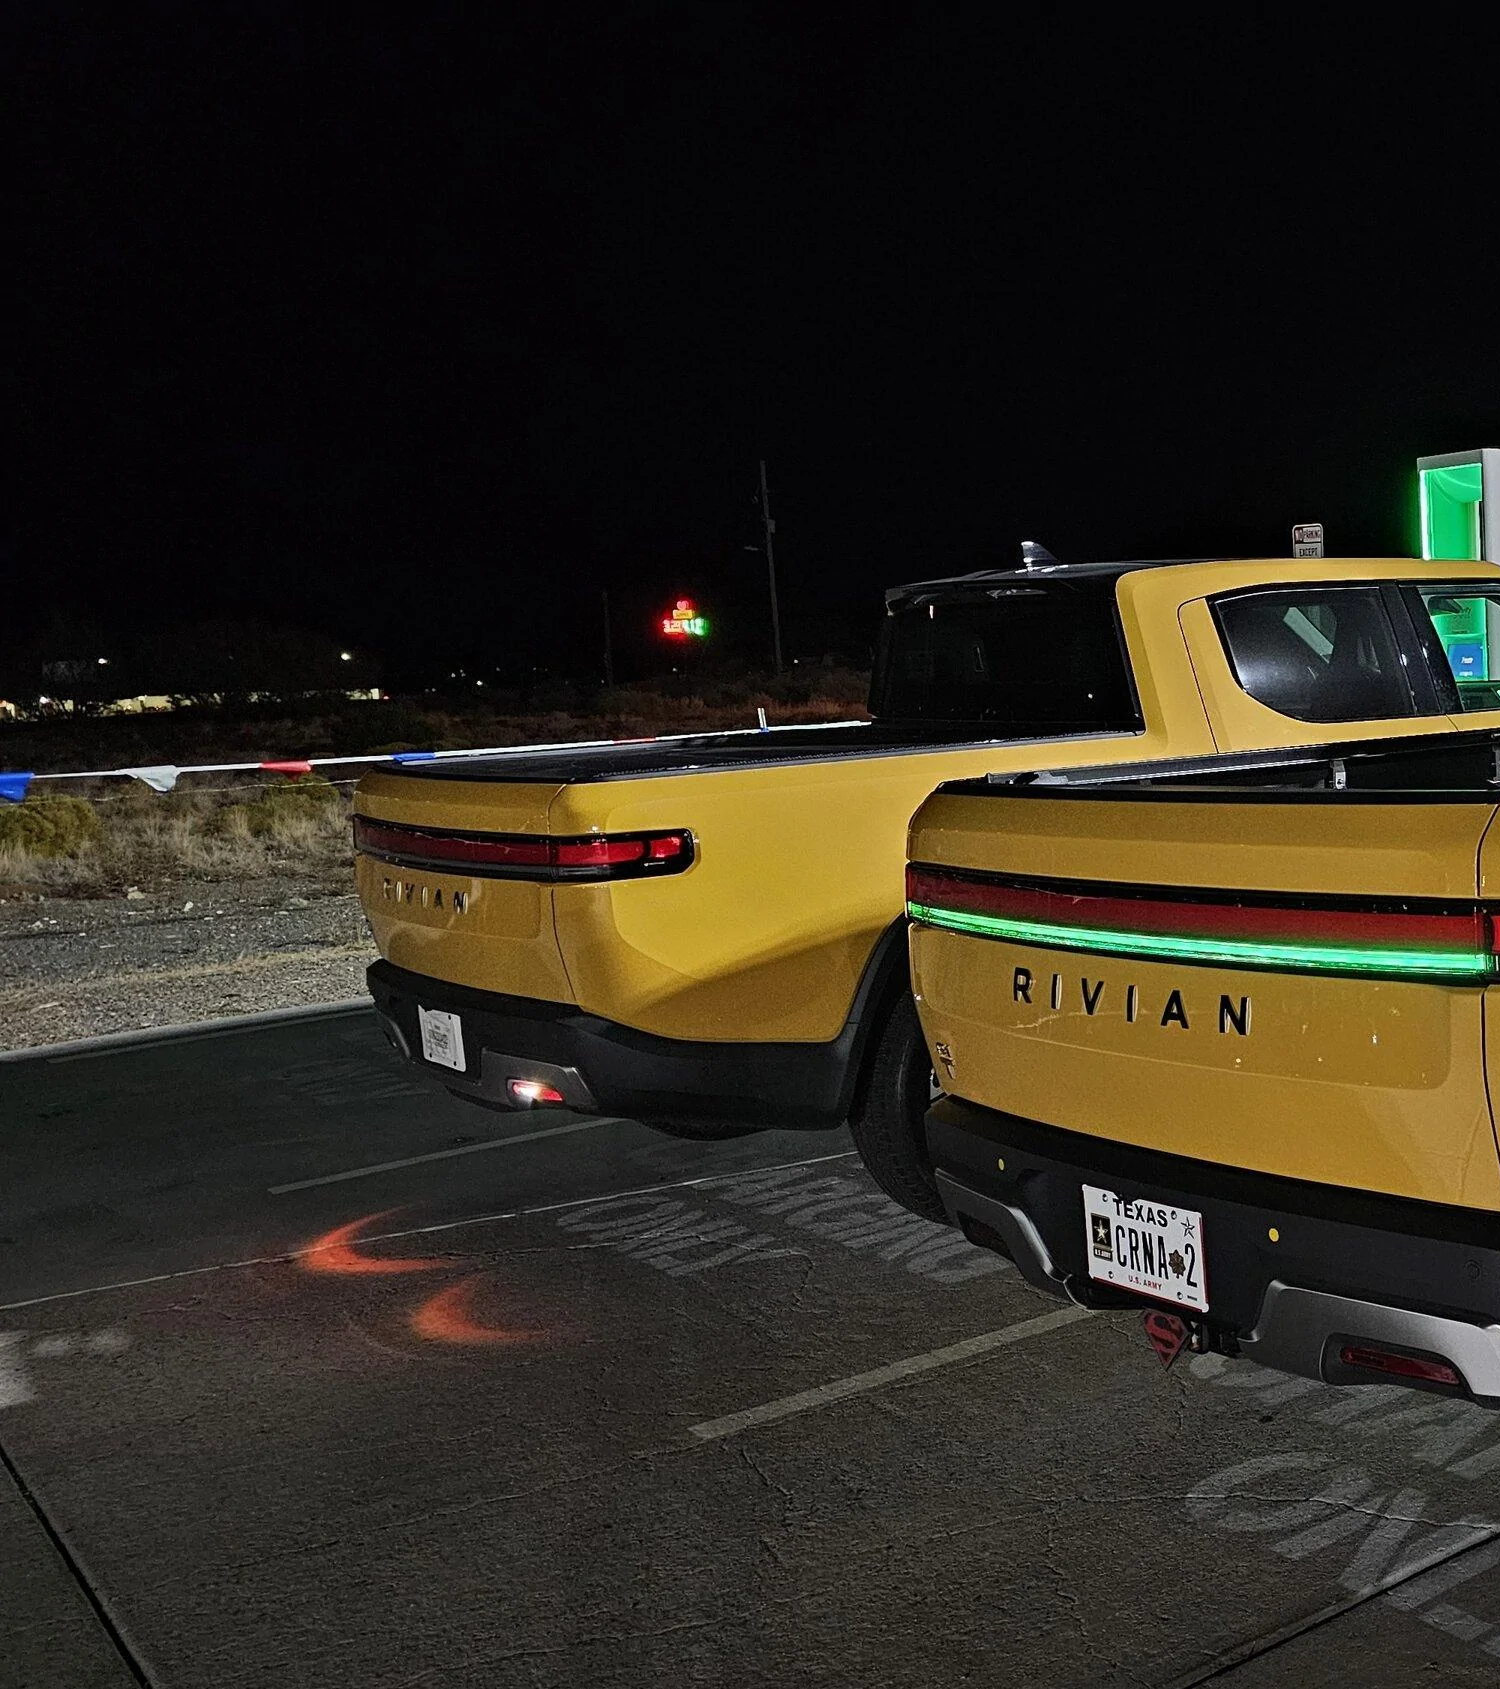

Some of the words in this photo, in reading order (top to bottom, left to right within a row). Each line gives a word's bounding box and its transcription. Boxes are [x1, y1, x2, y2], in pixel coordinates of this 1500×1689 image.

[1013, 966, 1252, 1036] RIVIAN
[1112, 1197, 1169, 1228] TEXAS
[1115, 1224, 1169, 1280] CRNA
[1184, 1243, 1198, 1288] 2
[1143, 1279, 1162, 1291] ARMY
